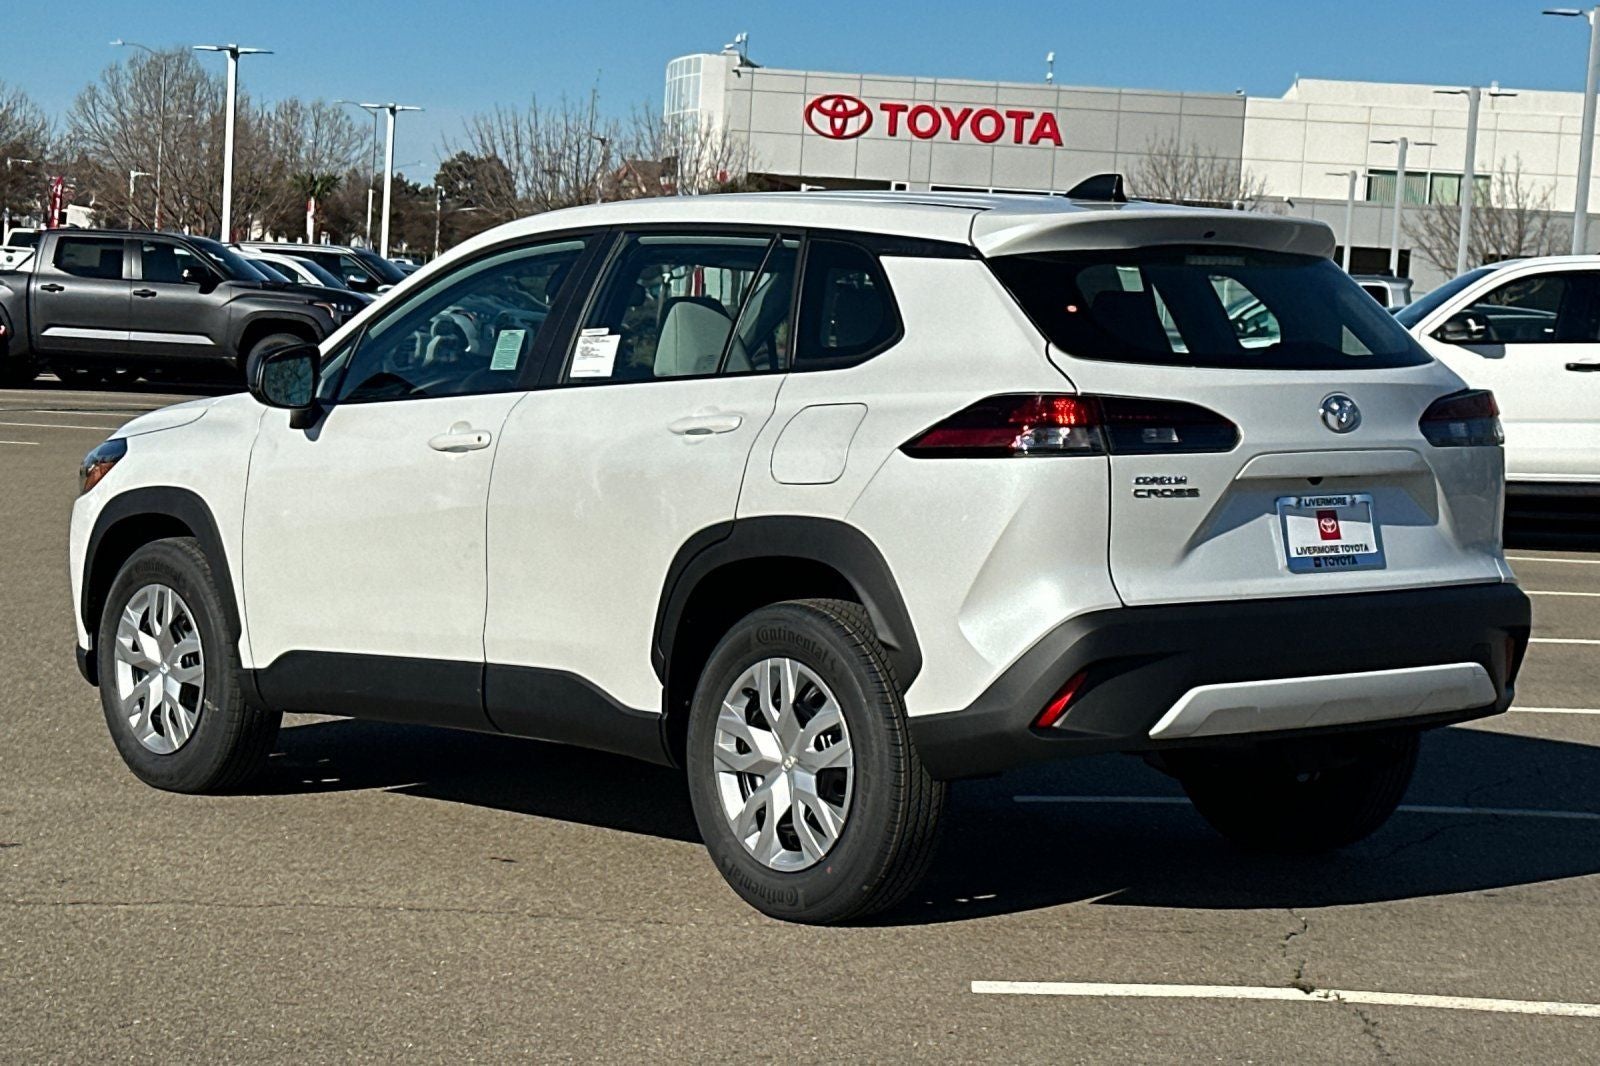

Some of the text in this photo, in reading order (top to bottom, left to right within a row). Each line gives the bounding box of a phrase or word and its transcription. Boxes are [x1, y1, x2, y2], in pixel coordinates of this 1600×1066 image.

[880, 103, 1063, 146] TOYOTA
[1304, 497, 1347, 507] LIVERMORE
[1296, 544, 1369, 556] LIVERMORE TOYOTA
[1322, 555, 1358, 567] TOYOTA
